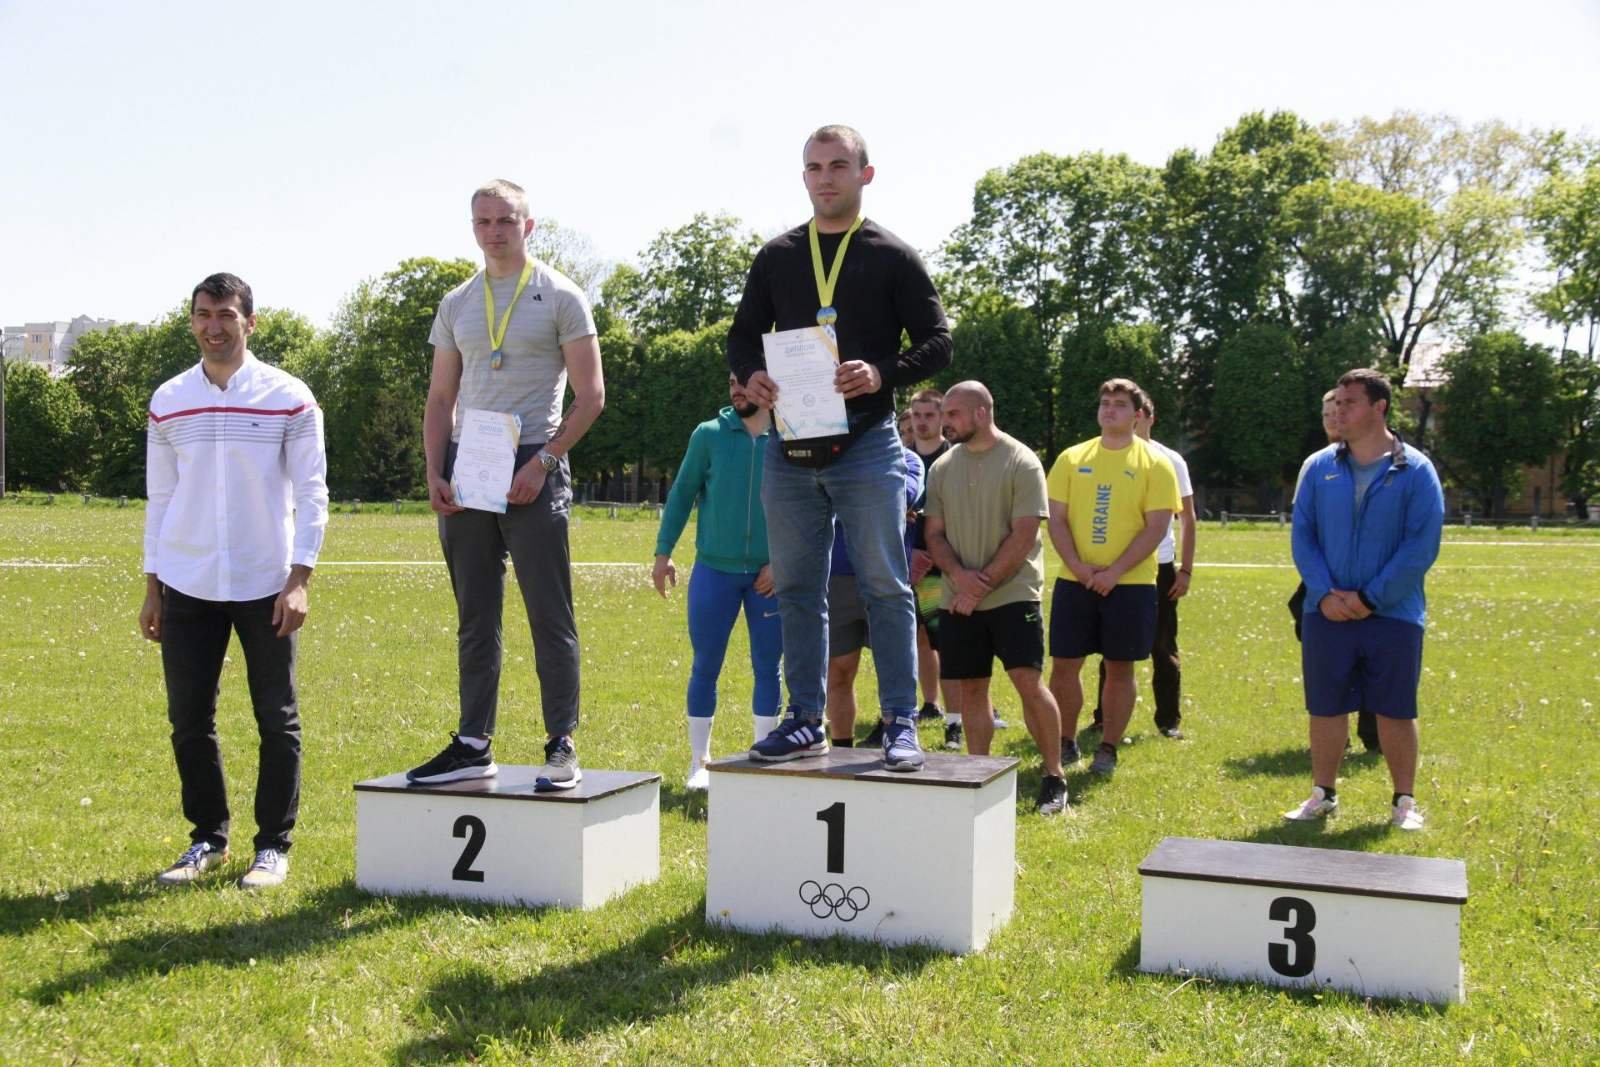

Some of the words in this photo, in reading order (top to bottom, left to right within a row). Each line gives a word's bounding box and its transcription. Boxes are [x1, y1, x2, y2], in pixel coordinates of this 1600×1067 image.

[1092, 484, 1112, 544] UKRAINE
[452, 815, 487, 882] 2
[816, 802, 846, 874] 1
[1268, 896, 1317, 978] 3
